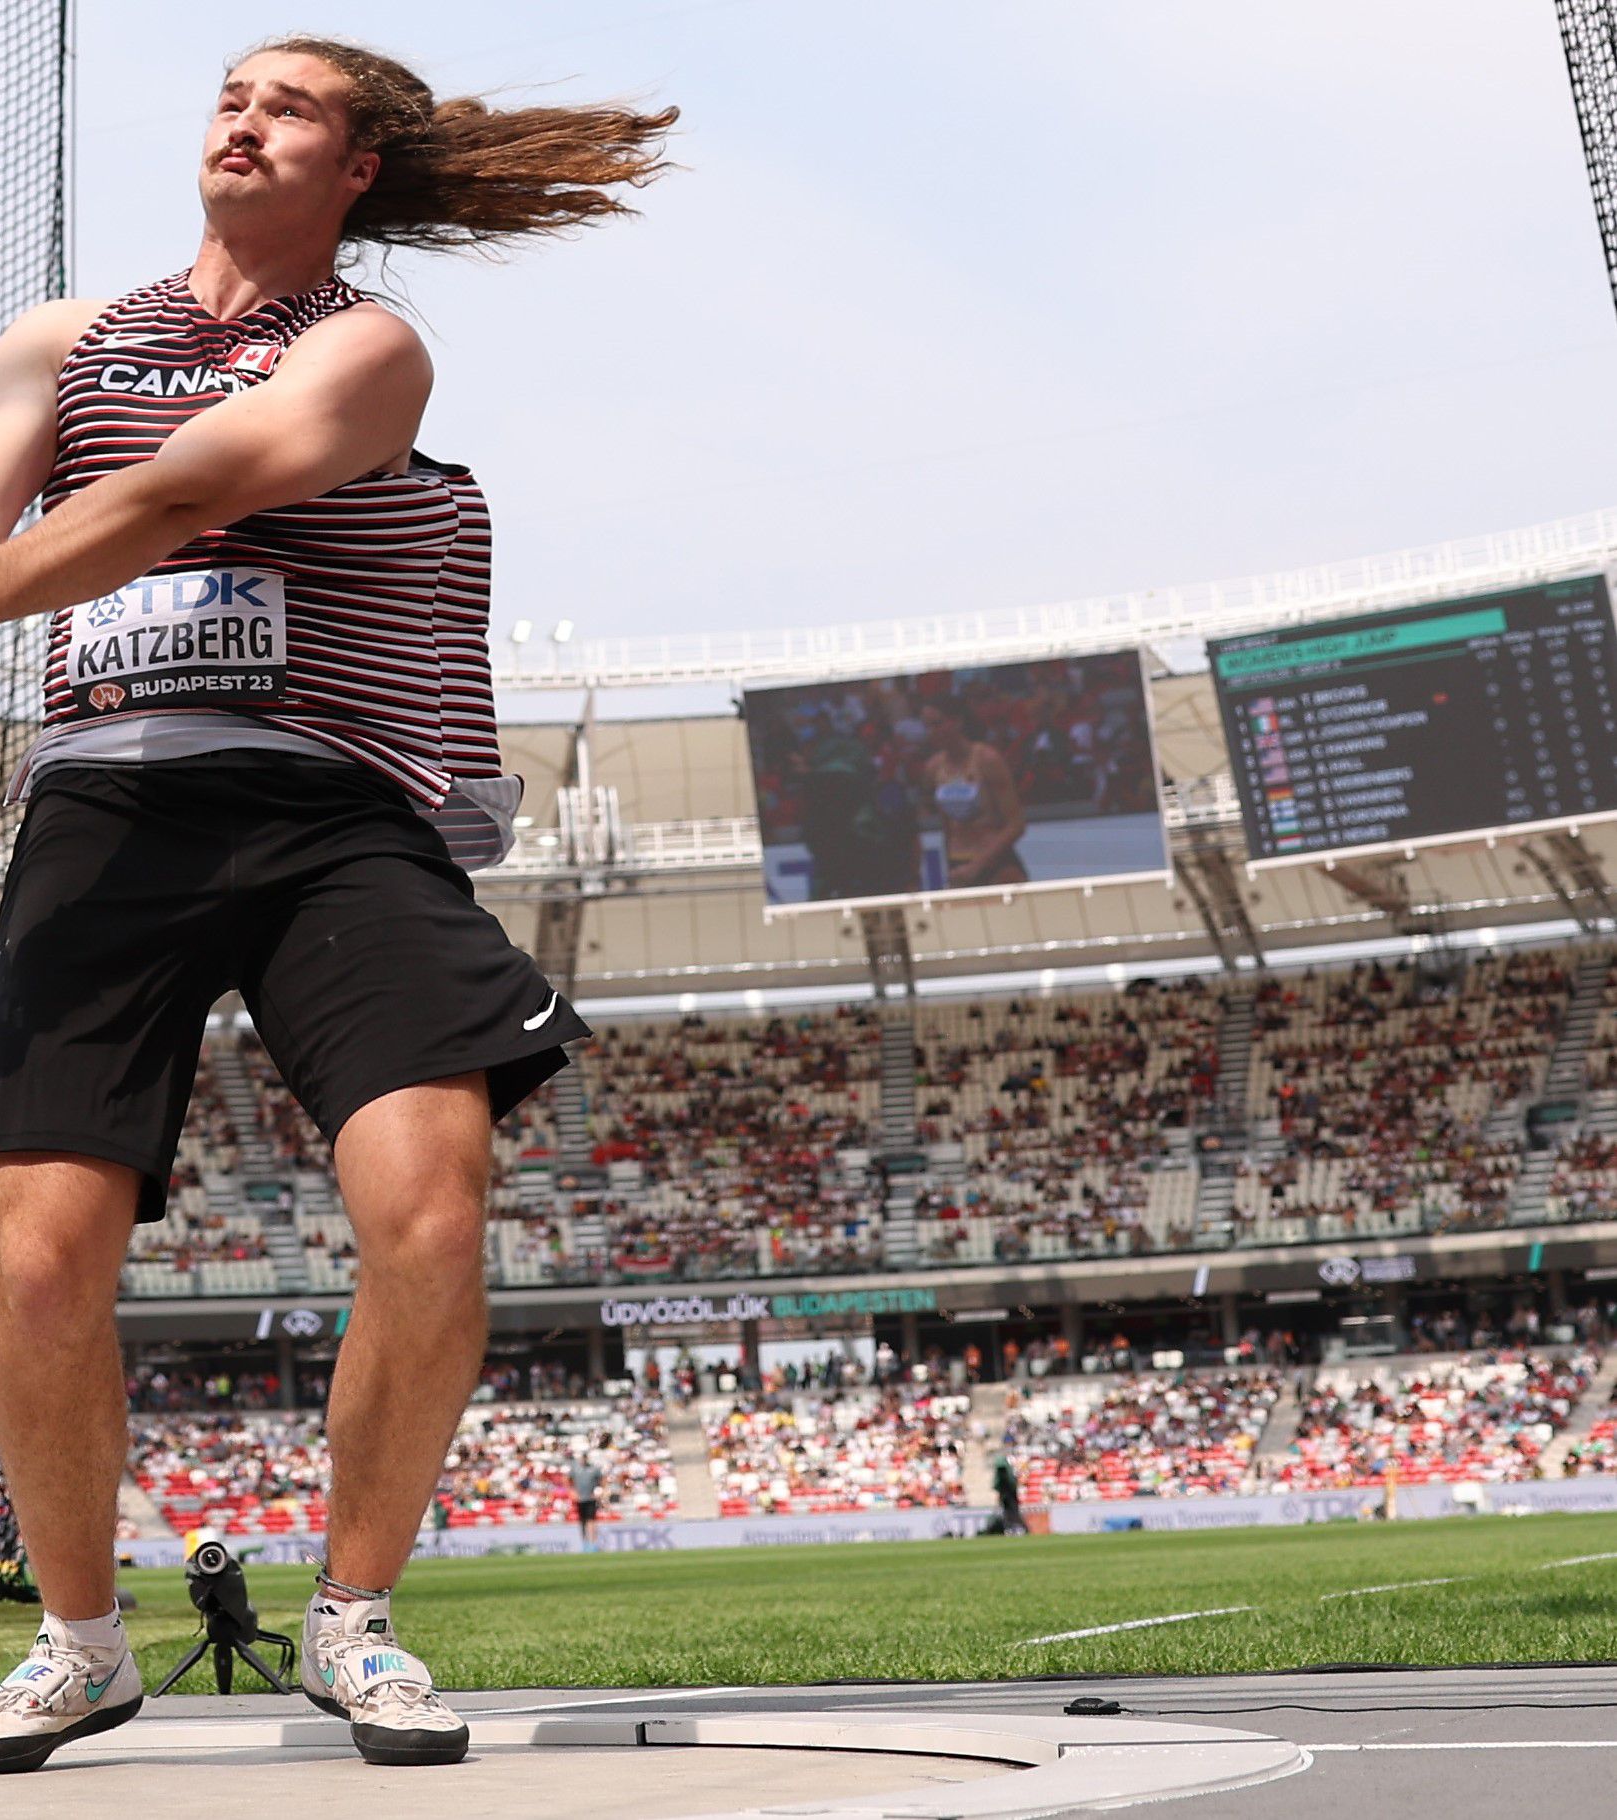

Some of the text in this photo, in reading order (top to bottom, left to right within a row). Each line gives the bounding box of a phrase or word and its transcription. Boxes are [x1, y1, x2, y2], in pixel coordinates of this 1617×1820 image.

[99, 363, 248, 398] CANA
[125, 572, 268, 614] TDK
[78, 616, 272, 679] KATZBERG
[131, 675, 273, 699] BUDAPEST 23
[601, 1289, 936, 1326] ÜDVÖZÖLJÜK BUDAPESTEN
[609, 1528, 674, 1550] TDK
[363, 1652, 408, 1681] NIKE
